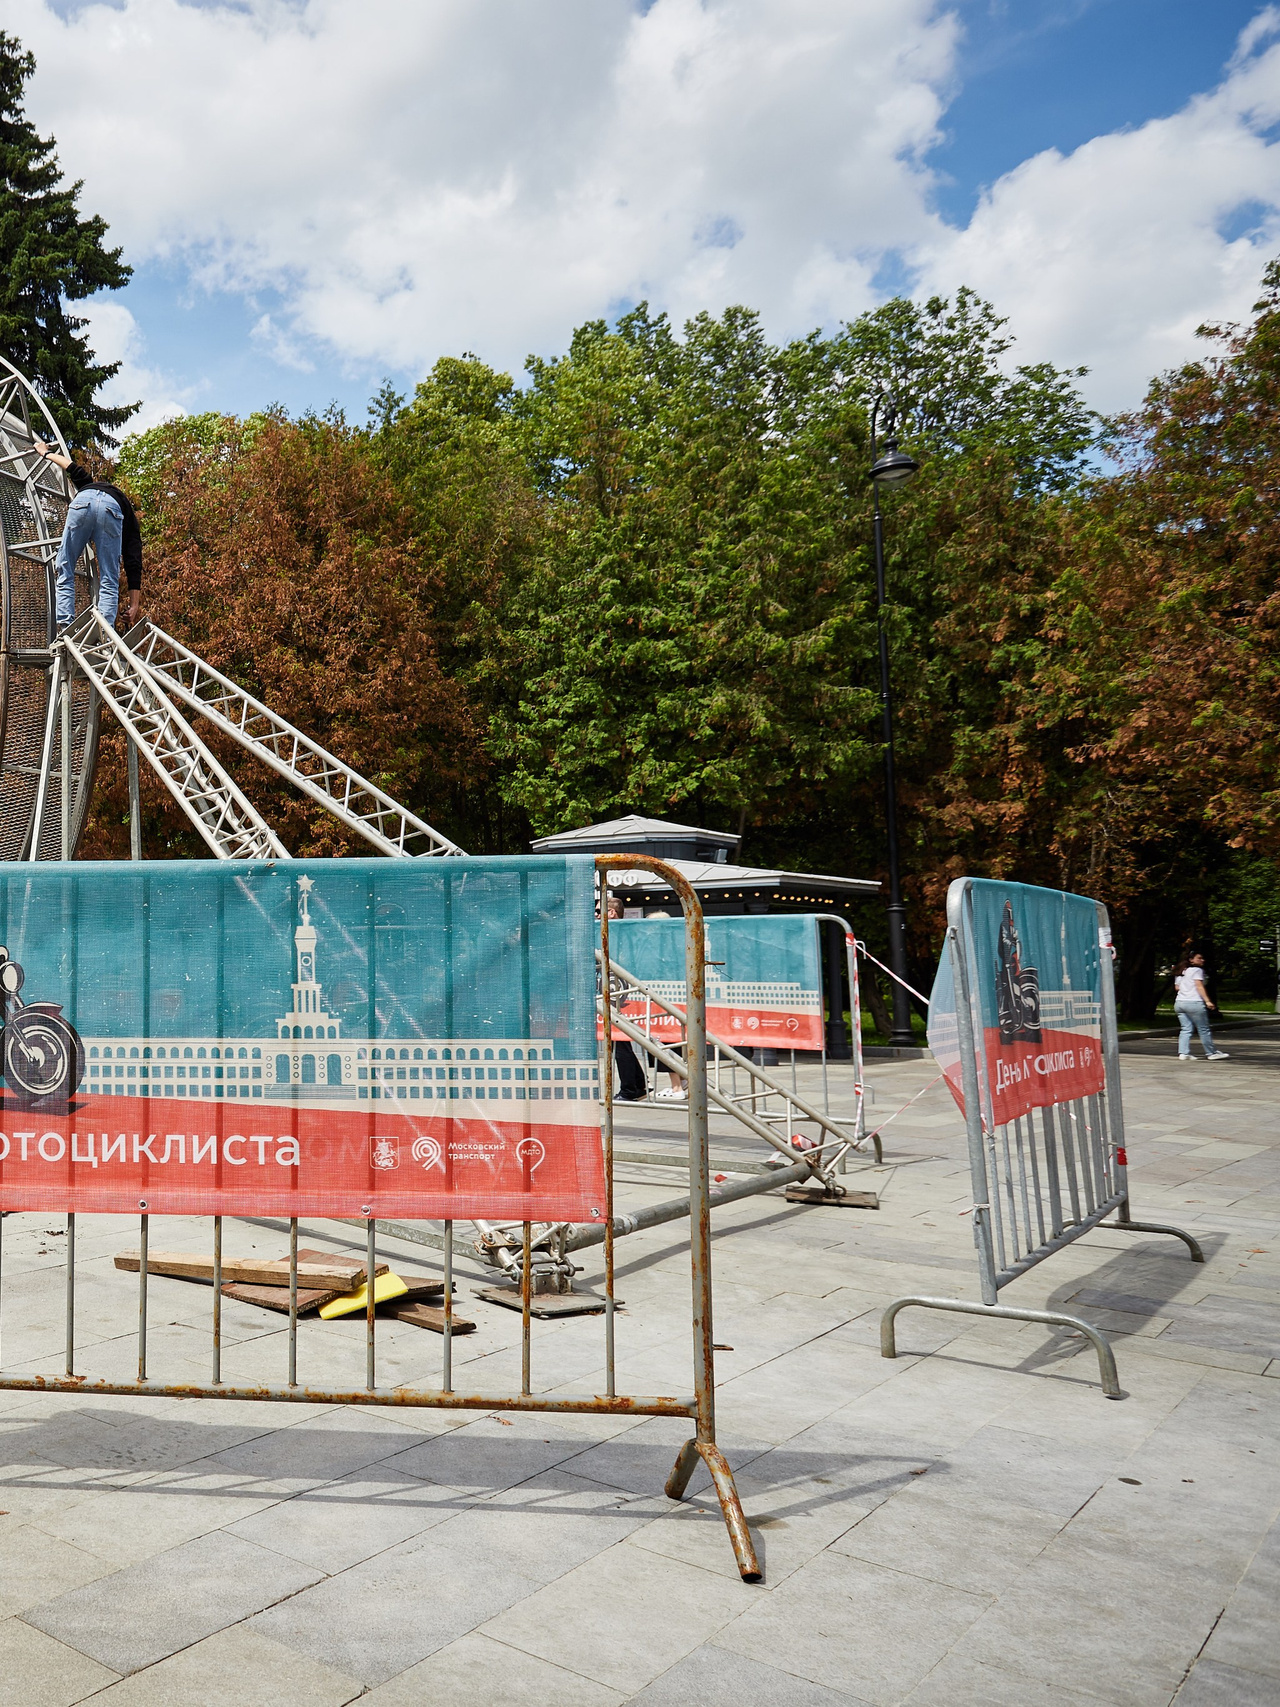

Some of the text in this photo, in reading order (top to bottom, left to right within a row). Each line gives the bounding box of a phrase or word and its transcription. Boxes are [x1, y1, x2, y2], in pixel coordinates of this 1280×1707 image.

[995, 1058, 1021, 1095] День
[448, 1141, 505, 1150] Московский
[448, 1153, 495, 1161] транспорт
